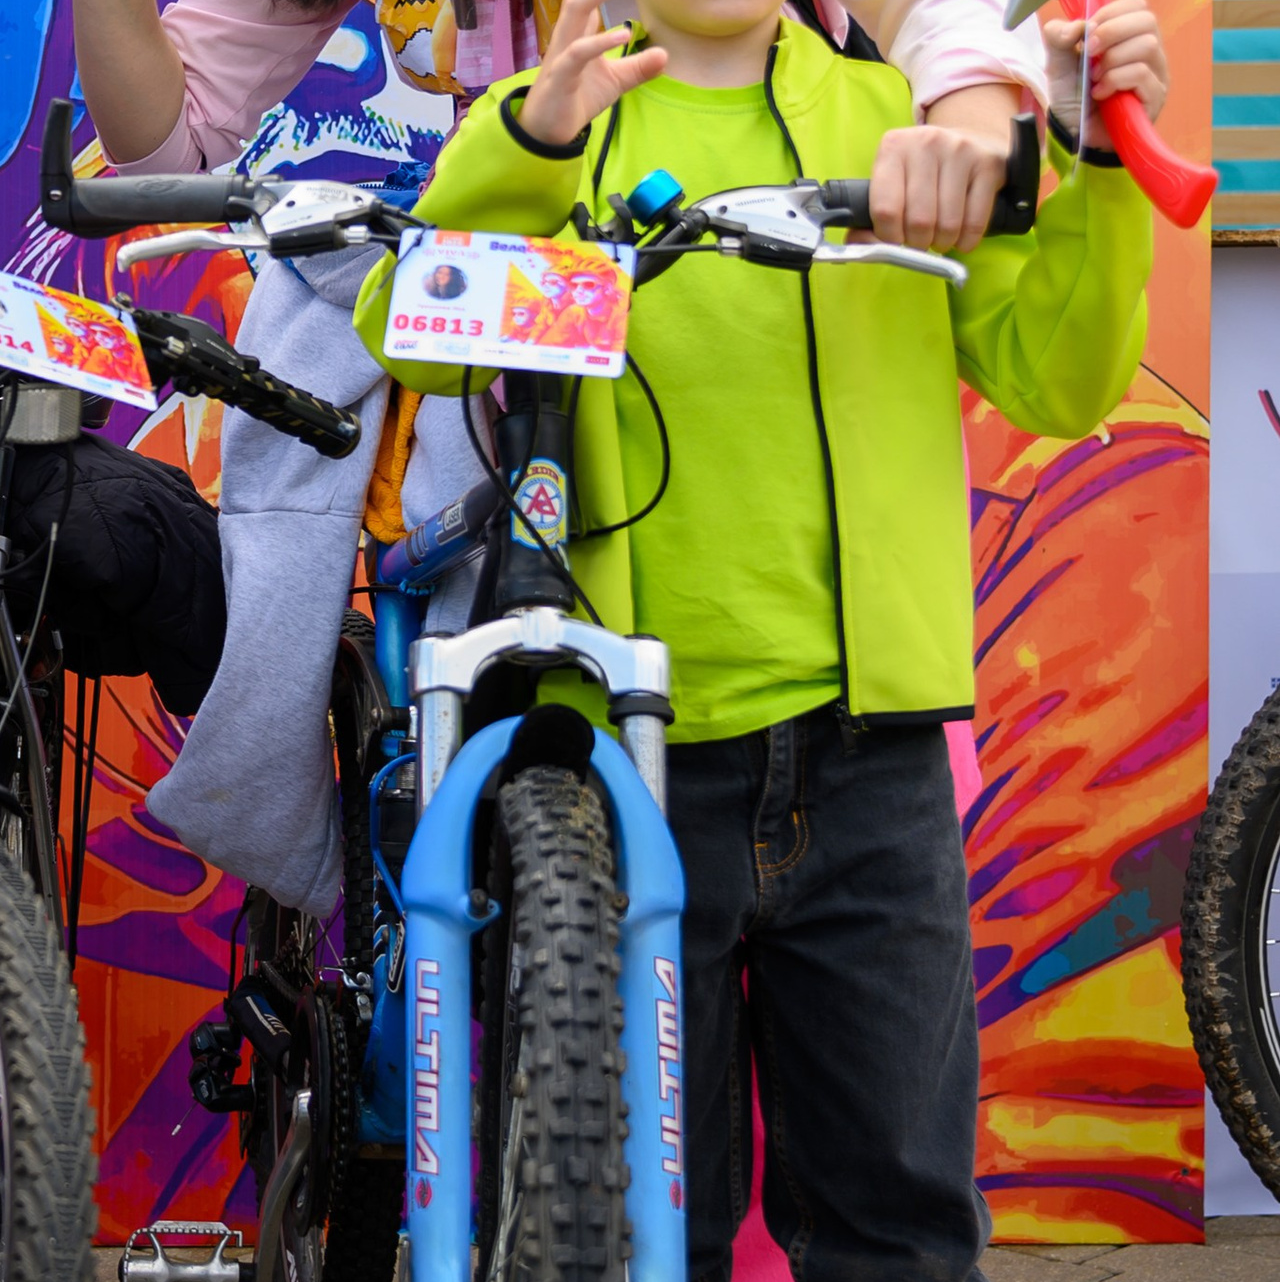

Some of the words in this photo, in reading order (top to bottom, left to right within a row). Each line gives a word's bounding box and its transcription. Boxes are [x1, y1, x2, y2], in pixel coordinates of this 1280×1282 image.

[393, 314, 484, 336] 06813
[415, 958, 439, 1175] ULTIMA
[653, 956, 682, 1175] ULTIMA
